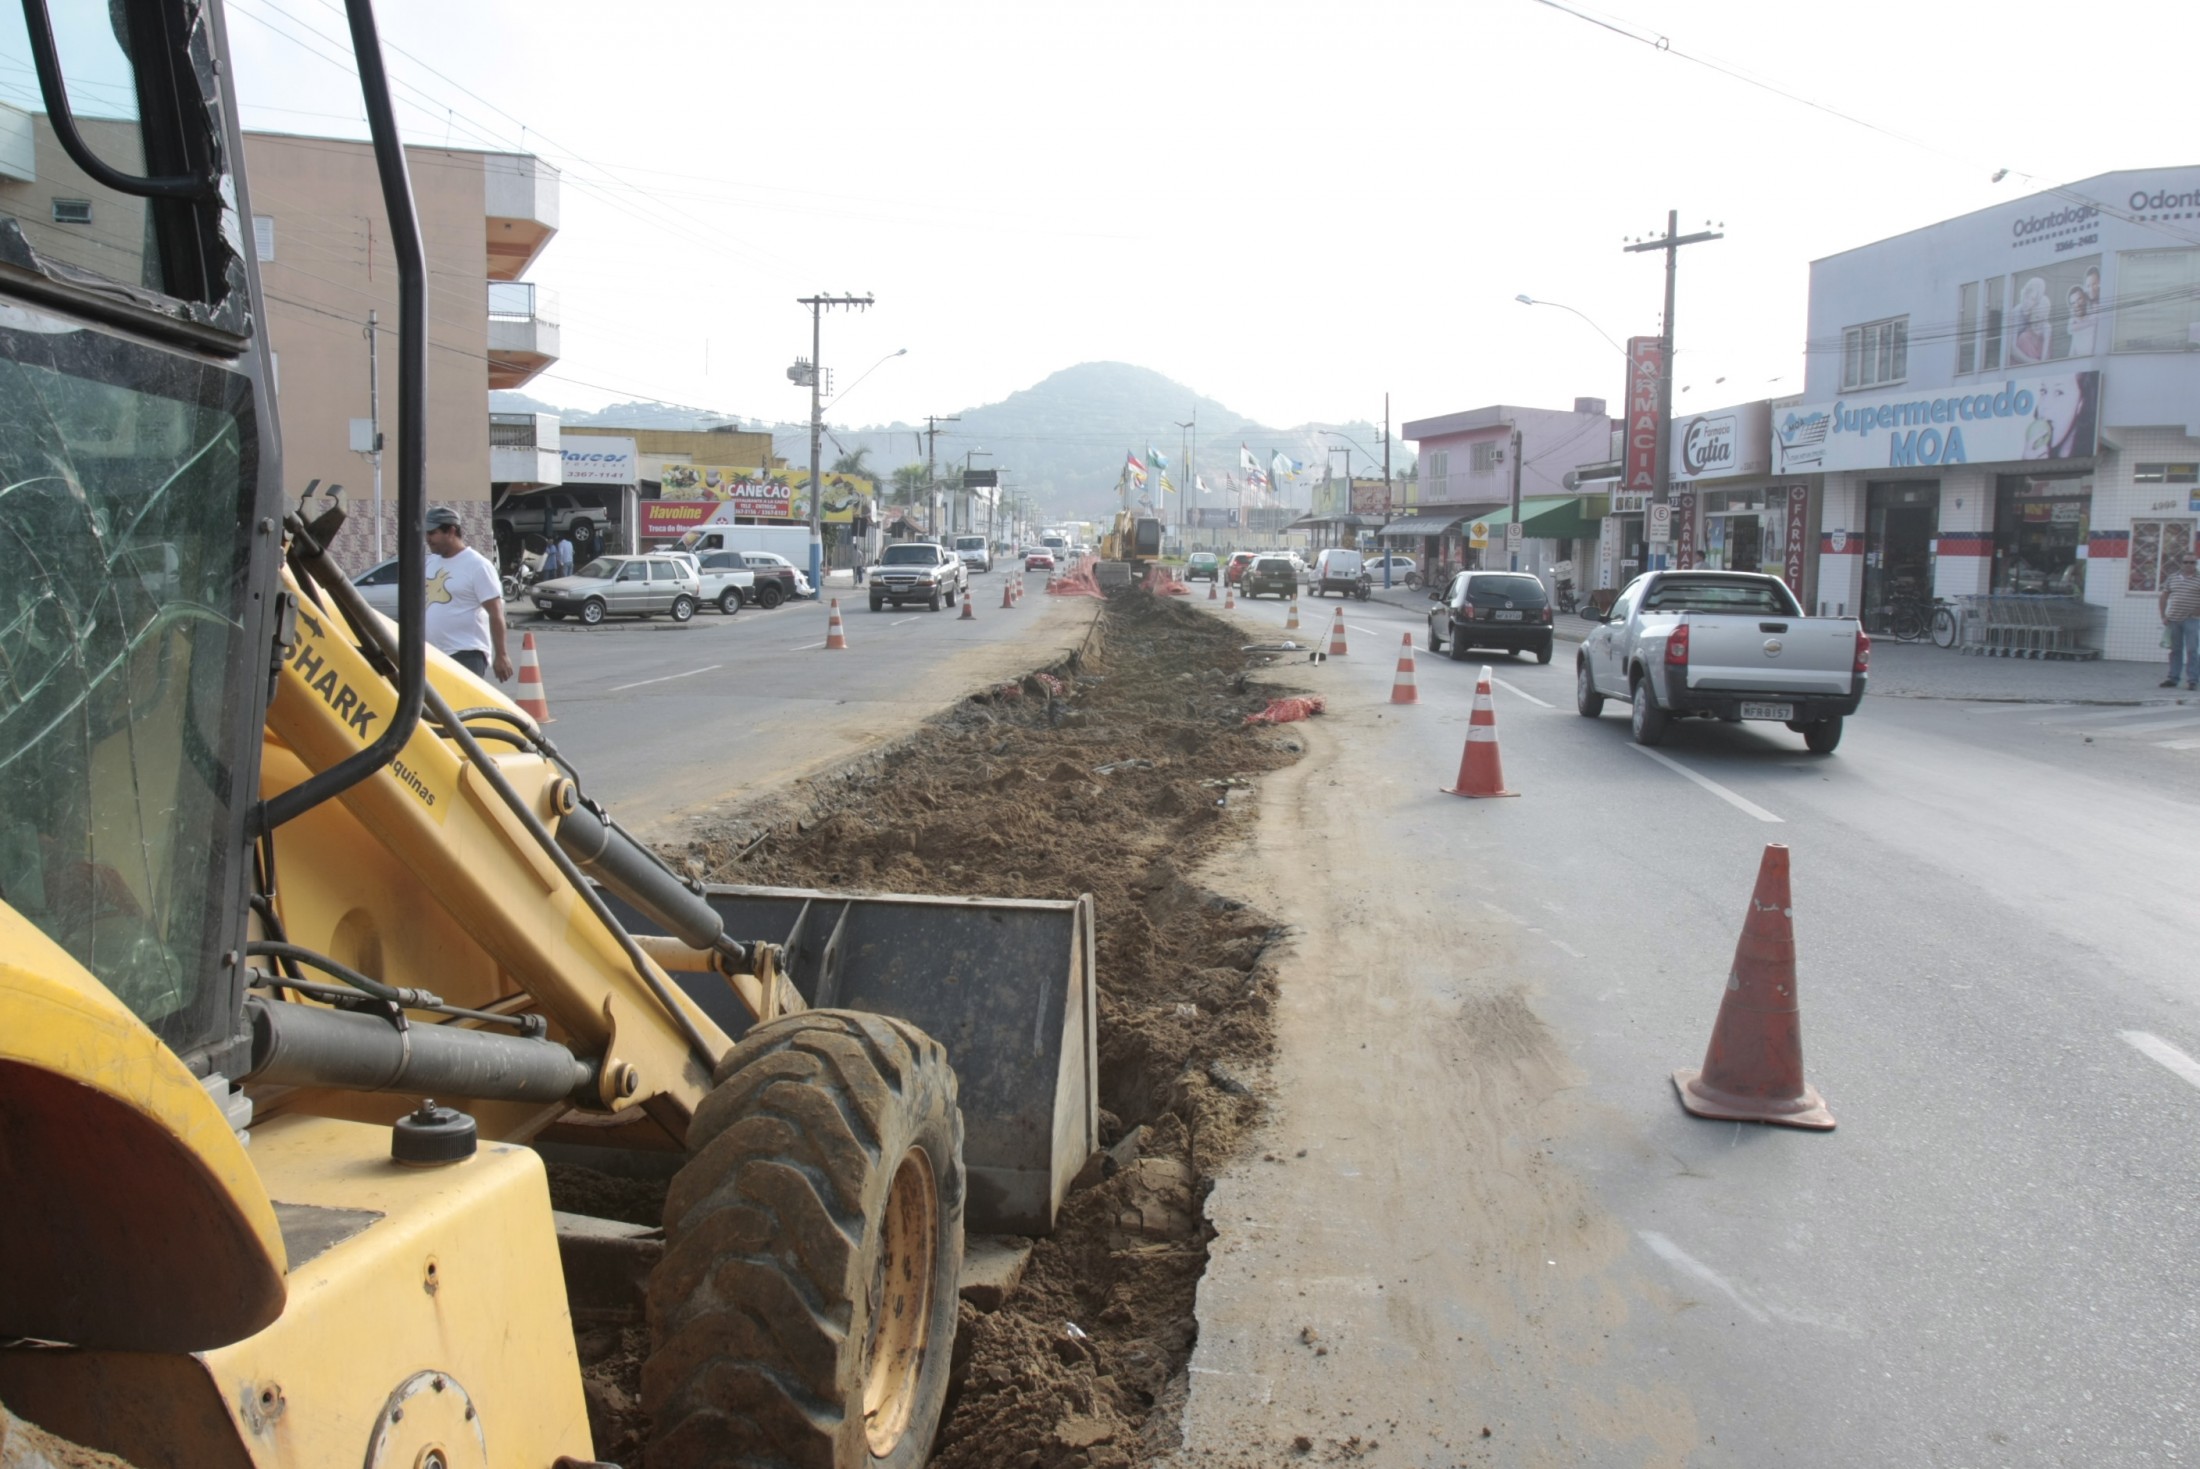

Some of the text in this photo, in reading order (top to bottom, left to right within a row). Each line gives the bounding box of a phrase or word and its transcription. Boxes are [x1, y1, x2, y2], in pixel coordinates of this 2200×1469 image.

[2013, 203, 2099, 238] Odontologia
[1832, 380, 2035, 437] Supermercado
[1889, 426, 1968, 467] MOA
[567, 471, 624, 479] 3367-1141
[727, 483, 791, 499] CANECÃO
[650, 505, 702, 520] Havoline
[1788, 503, 1803, 590] FARMÁCI
[284, 630, 379, 740] SHARK
[388, 758, 436, 807] quinas
